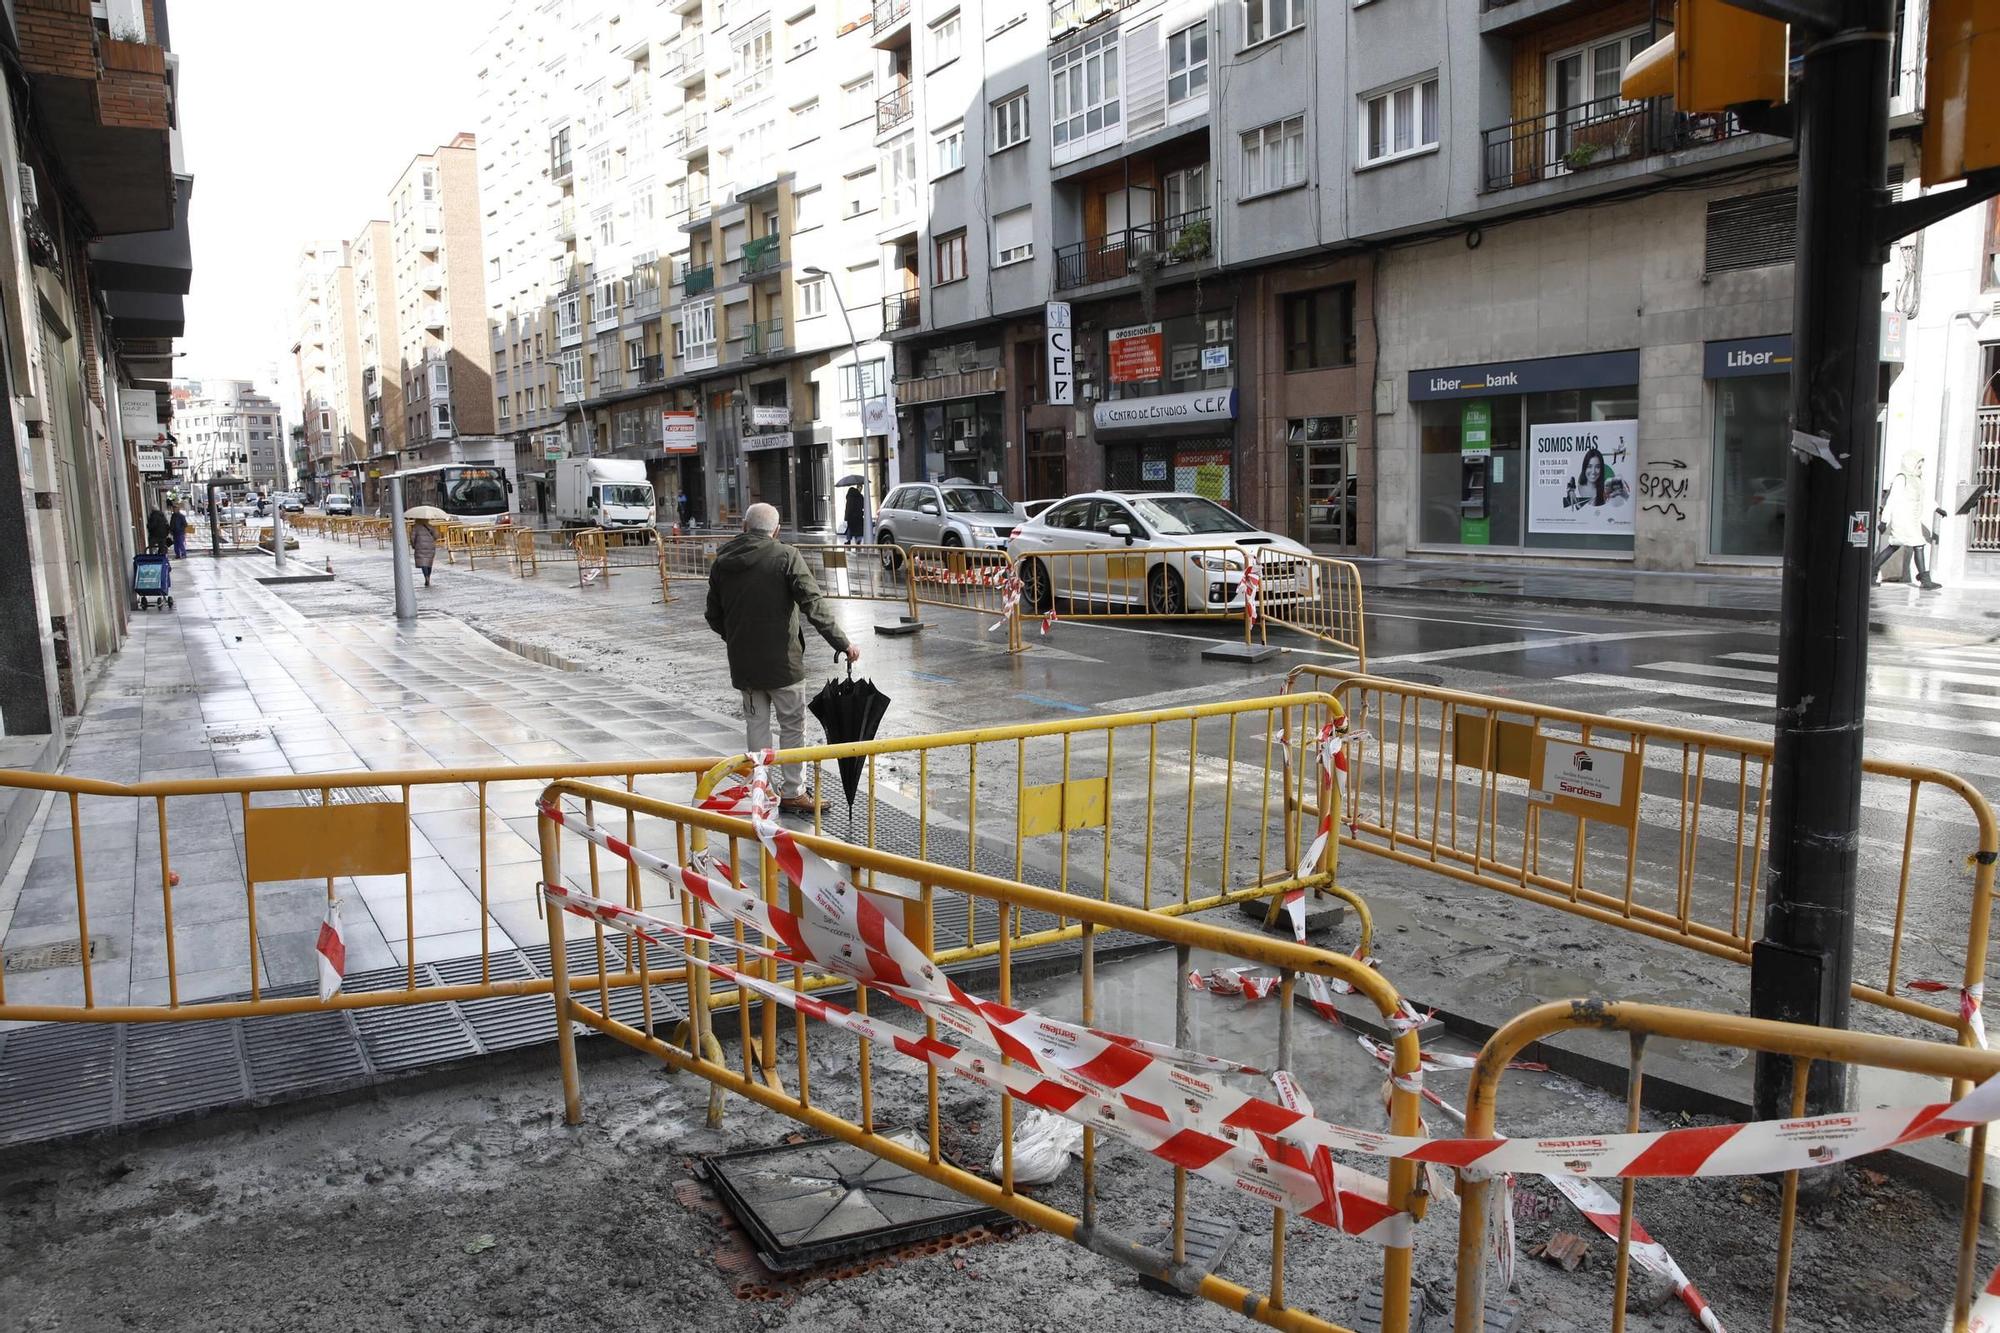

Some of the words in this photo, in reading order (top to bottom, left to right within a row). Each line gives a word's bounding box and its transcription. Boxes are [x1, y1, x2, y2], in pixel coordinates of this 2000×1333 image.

[1728, 351, 1773, 367] Liber
[1430, 378, 1461, 392] Liber
[1486, 372, 1518, 388] bank
[1193, 396, 1226, 413] C.E.P.
[1538, 436, 1573, 453] SOMOS
[1575, 432, 1599, 452] MÁS
[1560, 781, 1602, 799] Sardesa
[1040, 1022, 1077, 1041] Sardesa
[1779, 1117, 1853, 1130] Sardesa
[1537, 1139, 1603, 1148] Sardesa
[1235, 1178, 1282, 1202] Sardesa
